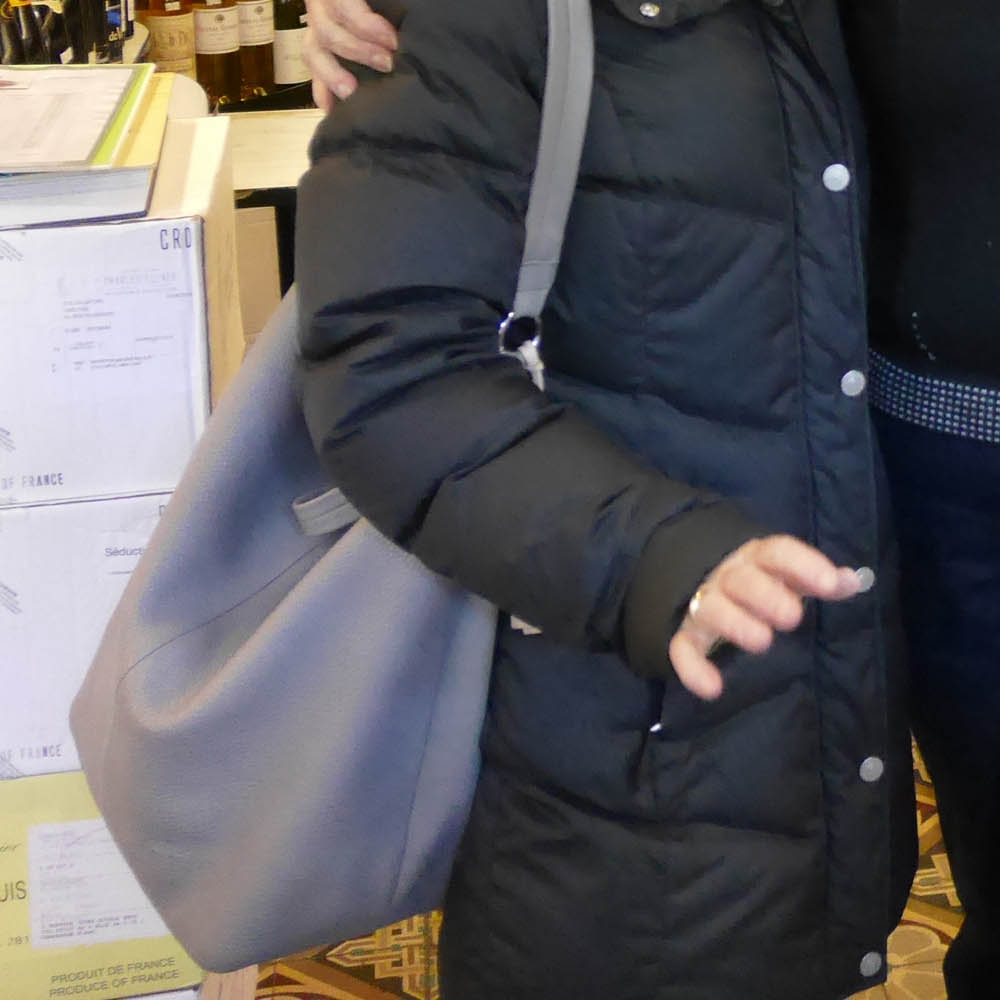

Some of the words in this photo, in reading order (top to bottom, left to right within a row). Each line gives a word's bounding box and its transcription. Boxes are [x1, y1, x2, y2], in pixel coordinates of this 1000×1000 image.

[22, 472, 64, 488] FRANCE
[48, 979, 109, 999] PRODUCE
[111, 976, 129, 990] OF
[130, 969, 181, 985] FRANCE
[50, 967, 106, 985] PRODUIT
[107, 964, 125, 977] DE
[127, 956, 177, 973] FRANCE
